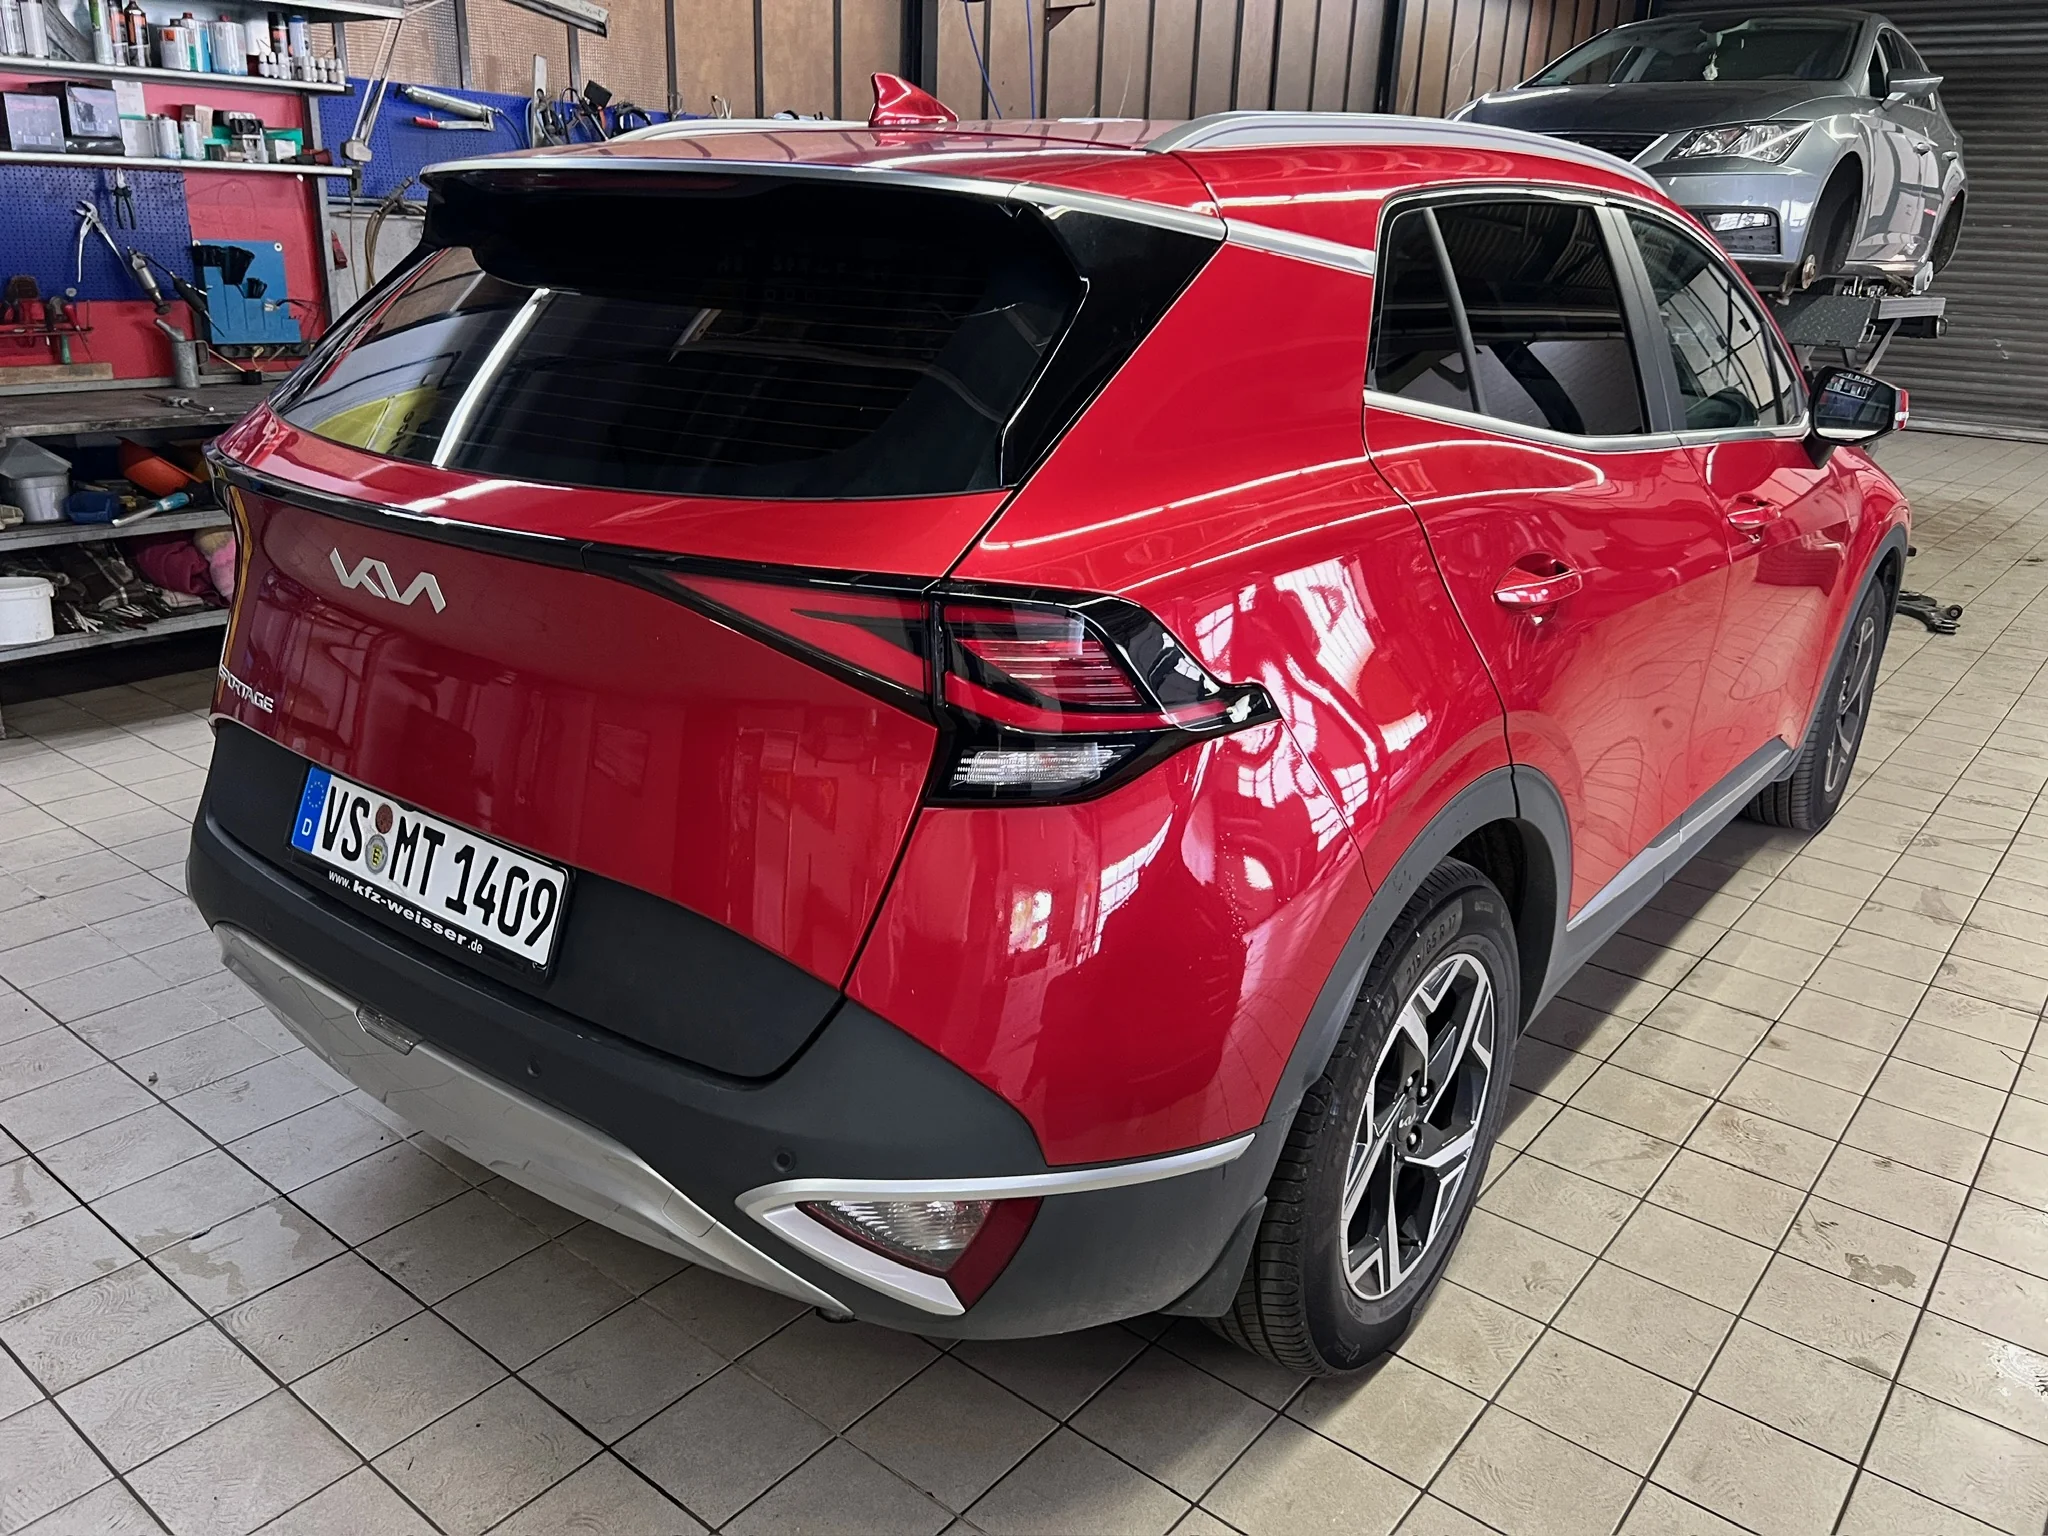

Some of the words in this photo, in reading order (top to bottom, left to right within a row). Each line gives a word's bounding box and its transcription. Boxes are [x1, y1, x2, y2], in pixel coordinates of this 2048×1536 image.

[329, 547, 446, 614] KIA
[301, 817, 312, 837] D
[321, 785, 370, 862] VS
[388, 815, 446, 897] MT
[444, 843, 558, 948] 1409
